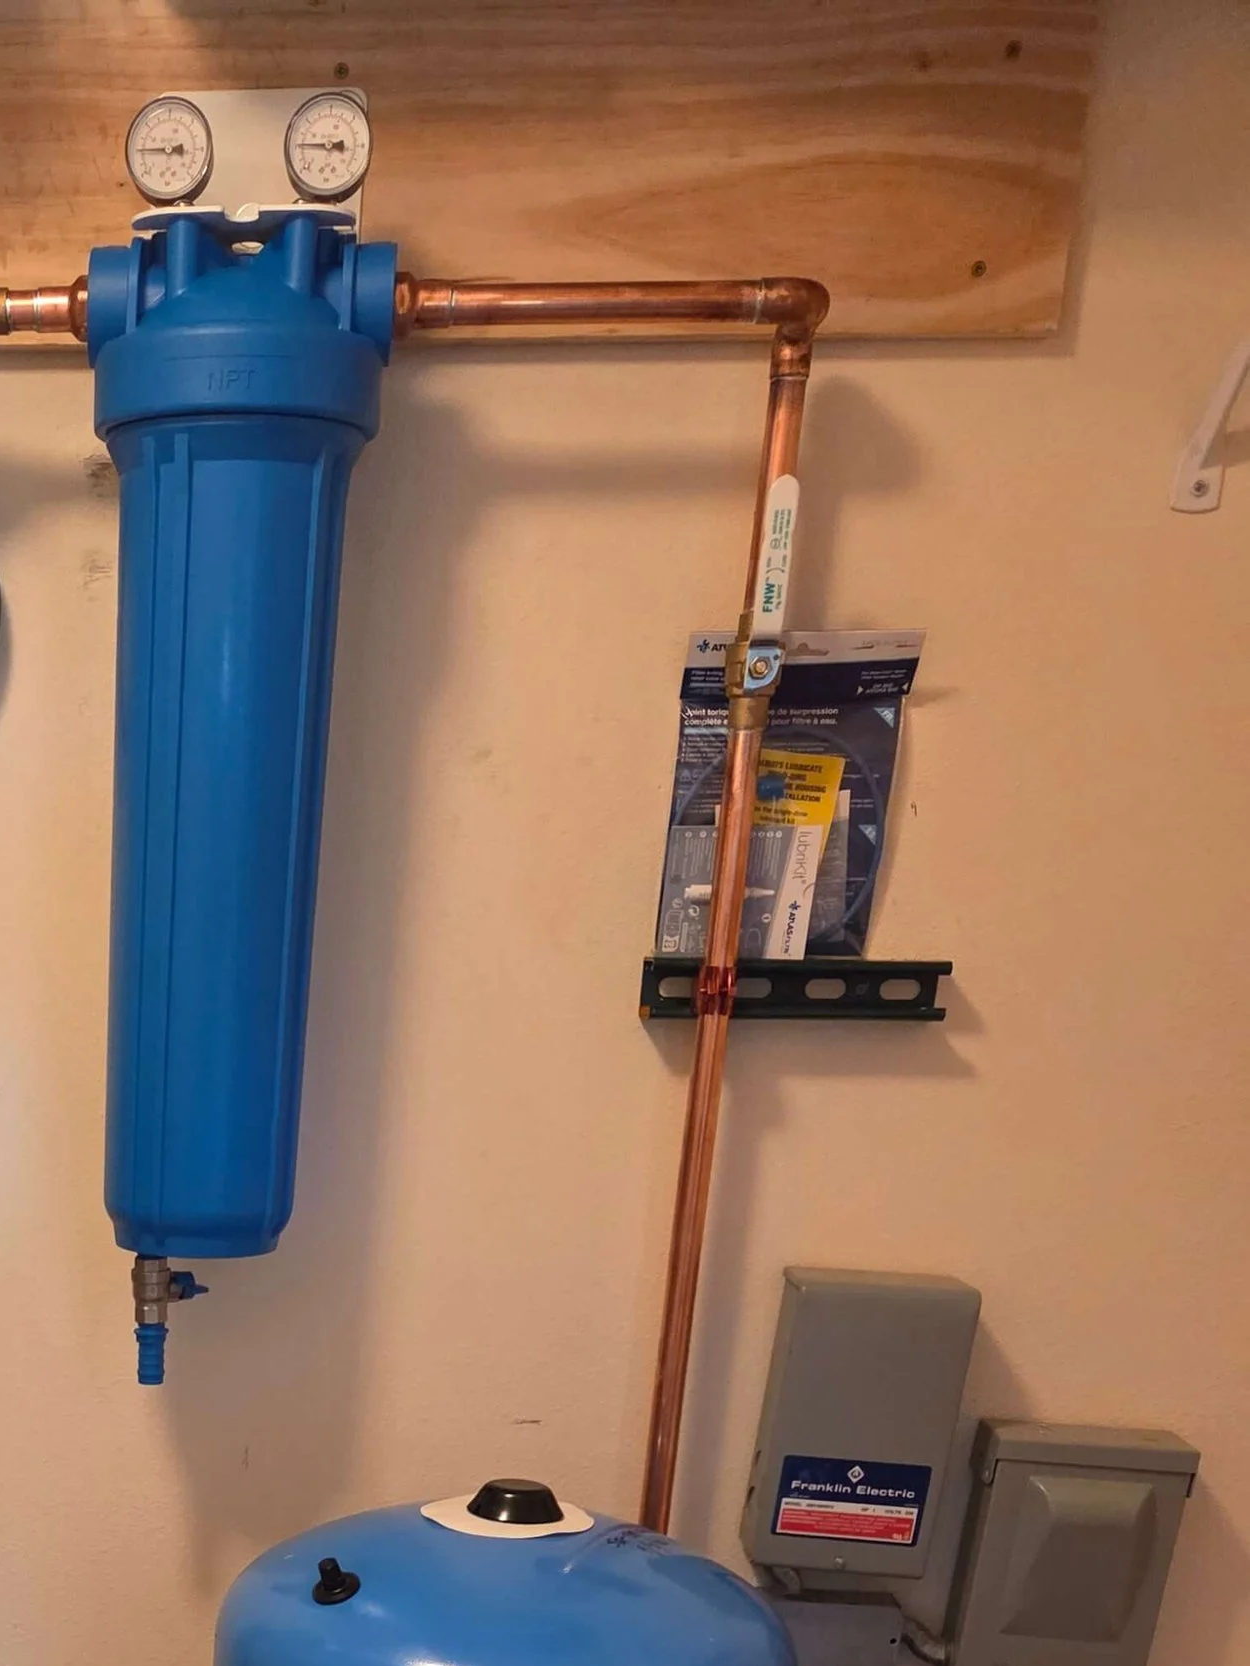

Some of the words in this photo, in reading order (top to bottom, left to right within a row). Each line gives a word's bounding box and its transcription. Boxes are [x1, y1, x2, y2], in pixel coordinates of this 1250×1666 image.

[207, 369, 256, 391] NPT
[762, 583, 776, 613] FNW
[789, 708, 839, 718] surpression
[791, 1480, 851, 1494] Franklin
[856, 1486, 915, 1499] Electric
